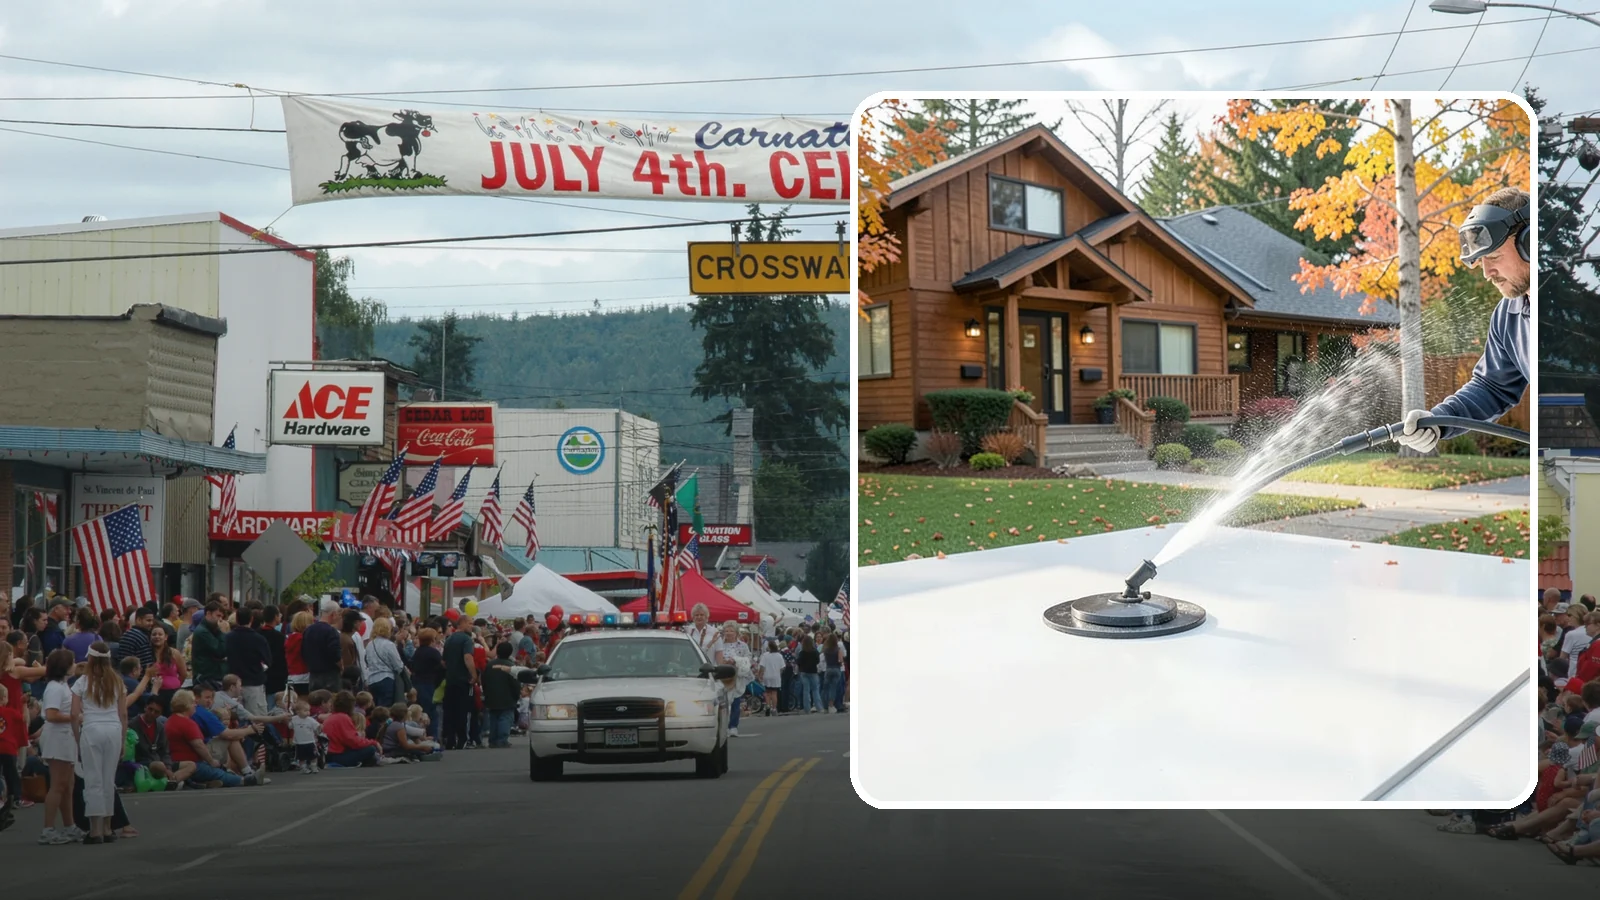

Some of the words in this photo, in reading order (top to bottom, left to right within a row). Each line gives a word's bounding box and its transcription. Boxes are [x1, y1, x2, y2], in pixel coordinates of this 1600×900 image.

[481, 140, 605, 193] JULY
[632, 149, 746, 198] 4th.
[696, 254, 850, 280] CROSSWA
[282, 379, 373, 420] ACE
[405, 409, 453, 421] CEDAR
[283, 420, 371, 436] Hardware
[96, 485, 124, 495] Vincent
[126, 486, 136, 494] de
[137, 486, 155, 495] Paul
[688, 526, 741, 535] CRNATION
[699, 535, 730, 544] GLASS
